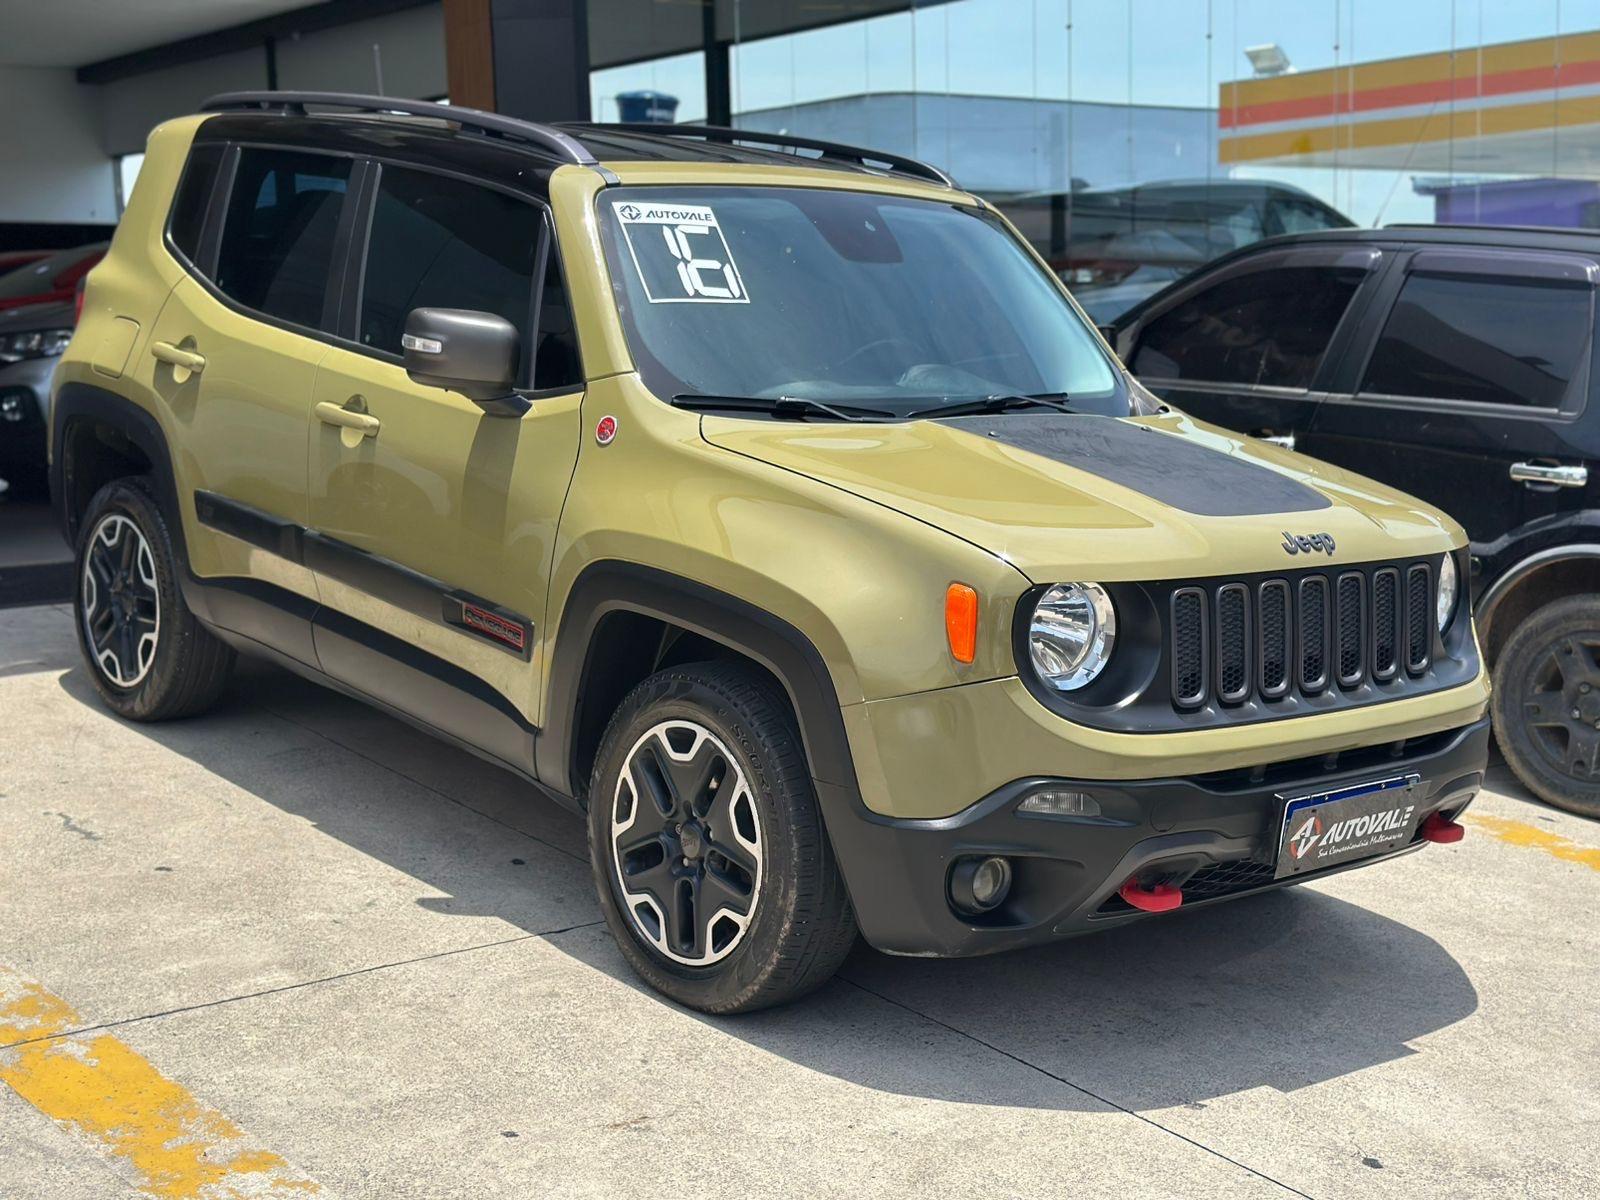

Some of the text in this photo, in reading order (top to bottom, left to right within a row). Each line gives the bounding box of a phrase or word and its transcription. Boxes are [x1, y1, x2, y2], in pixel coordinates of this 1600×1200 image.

[646, 210, 713, 222] AUTOVALE
[662, 225, 741, 299] 16
[1281, 531, 1336, 556] Jeep
[1318, 805, 1415, 847] AUTOVALE
